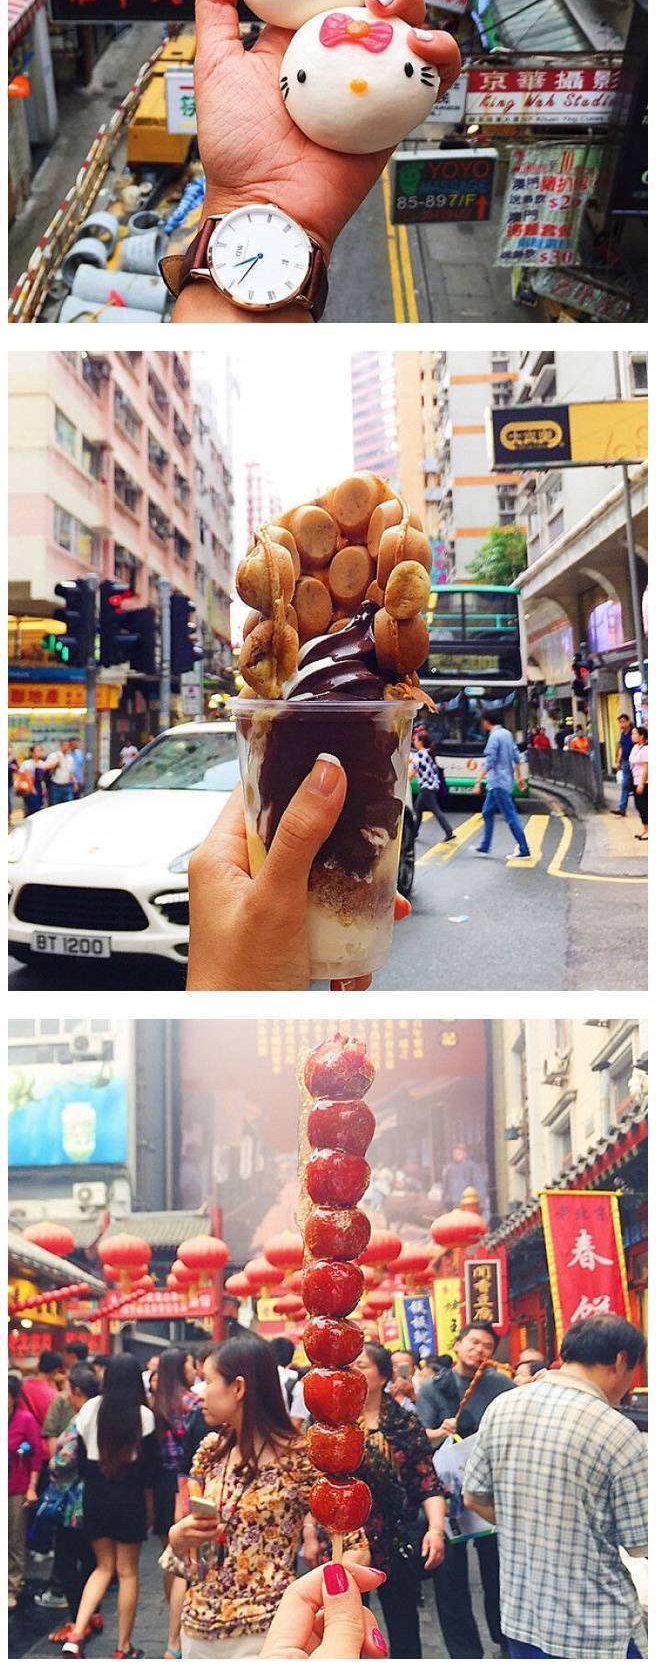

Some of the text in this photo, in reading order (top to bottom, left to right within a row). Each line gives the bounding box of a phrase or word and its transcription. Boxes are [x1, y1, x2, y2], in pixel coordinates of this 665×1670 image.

[479, 69, 621, 91] 京華攝影
[479, 92, 516, 114] King
[523, 92, 555, 107] Wah
[429, 158, 491, 179] YOYO
[36, 934, 103, 955] BT 1200
